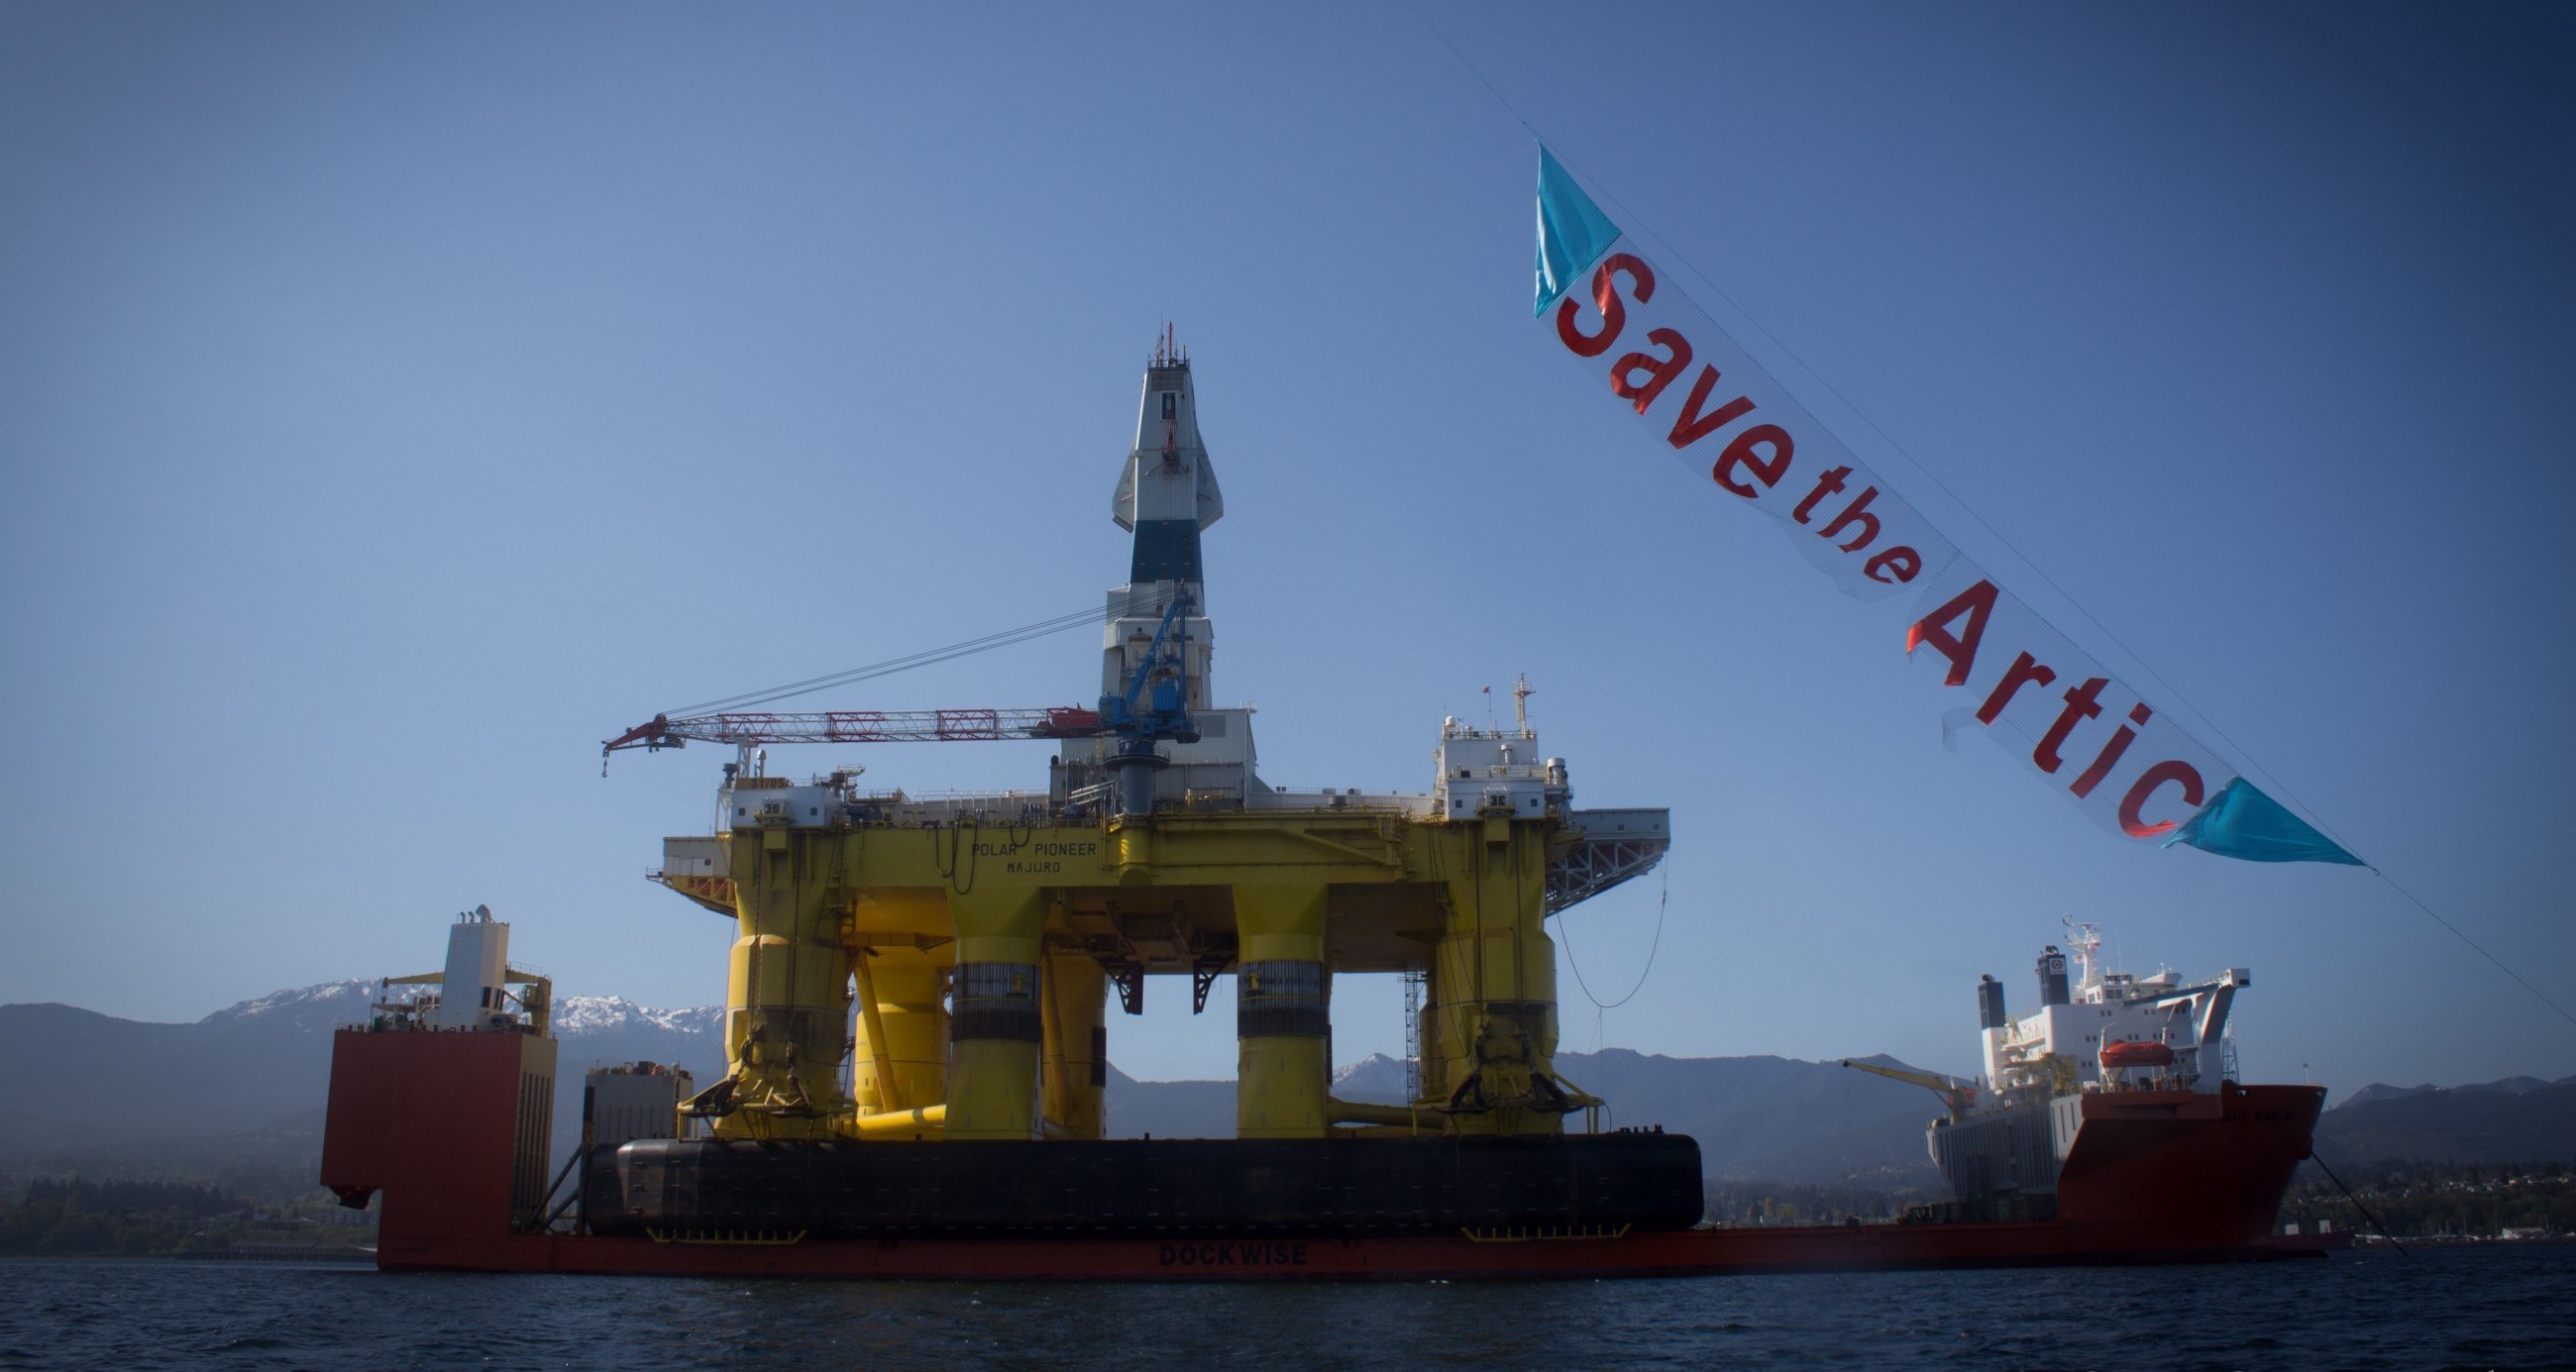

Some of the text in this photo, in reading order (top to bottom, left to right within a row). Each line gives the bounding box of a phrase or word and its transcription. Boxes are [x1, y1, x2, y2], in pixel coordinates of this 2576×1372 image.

[1556, 253, 2204, 838] Save the Artic
[972, 843, 1097, 857] POLAR PIONEER
[1007, 862, 1061, 873] MAJURO
[1160, 1244, 1308, 1266] DOCKWISE
